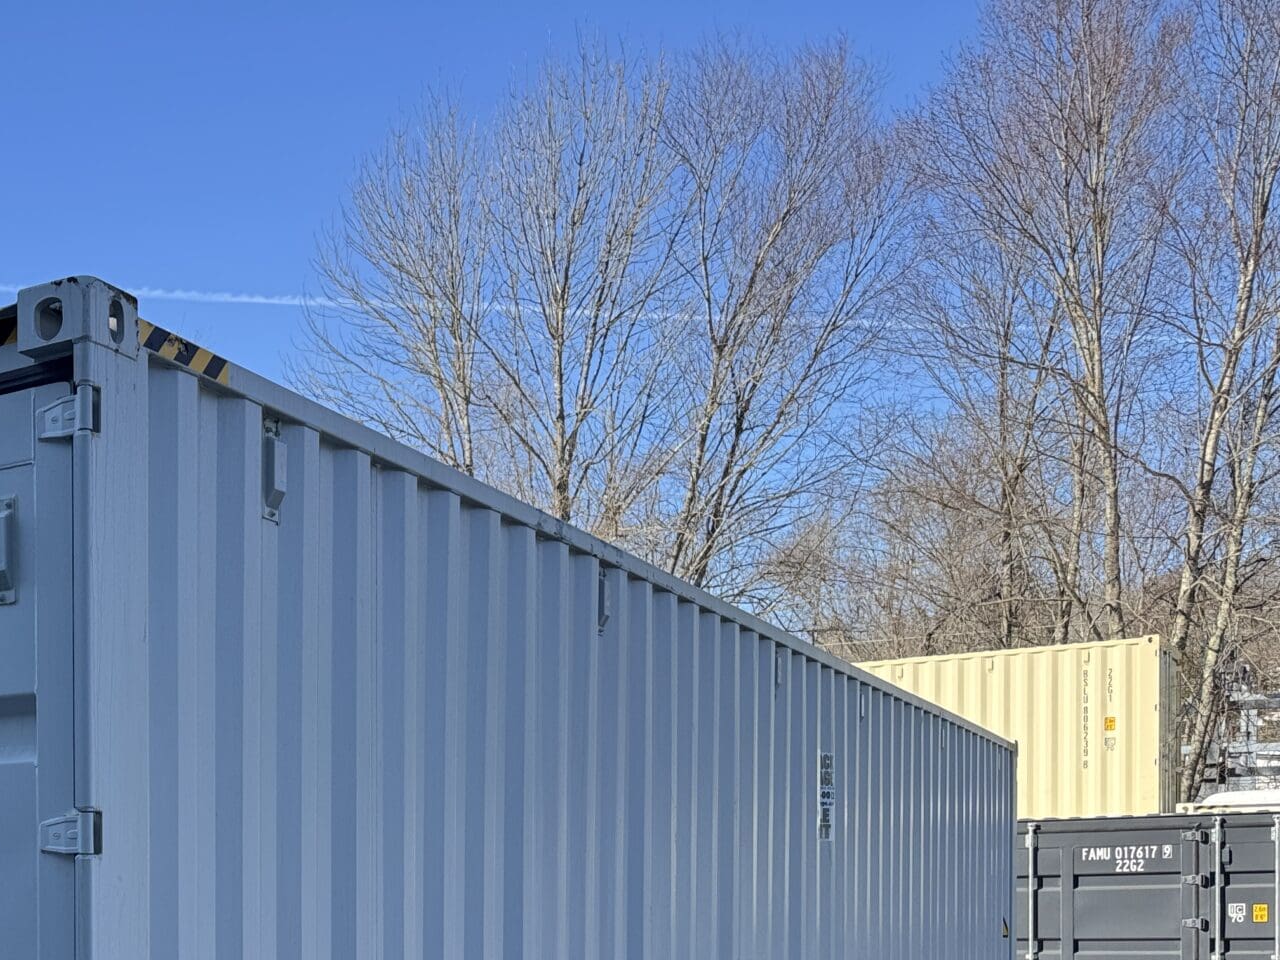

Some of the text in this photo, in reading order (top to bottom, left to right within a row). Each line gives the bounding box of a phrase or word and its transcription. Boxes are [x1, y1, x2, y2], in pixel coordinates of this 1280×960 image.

[1082, 847, 1111, 861] FAMU
[1115, 845, 1158, 859] 017617
[1115, 859, 1145, 872] 22G2
